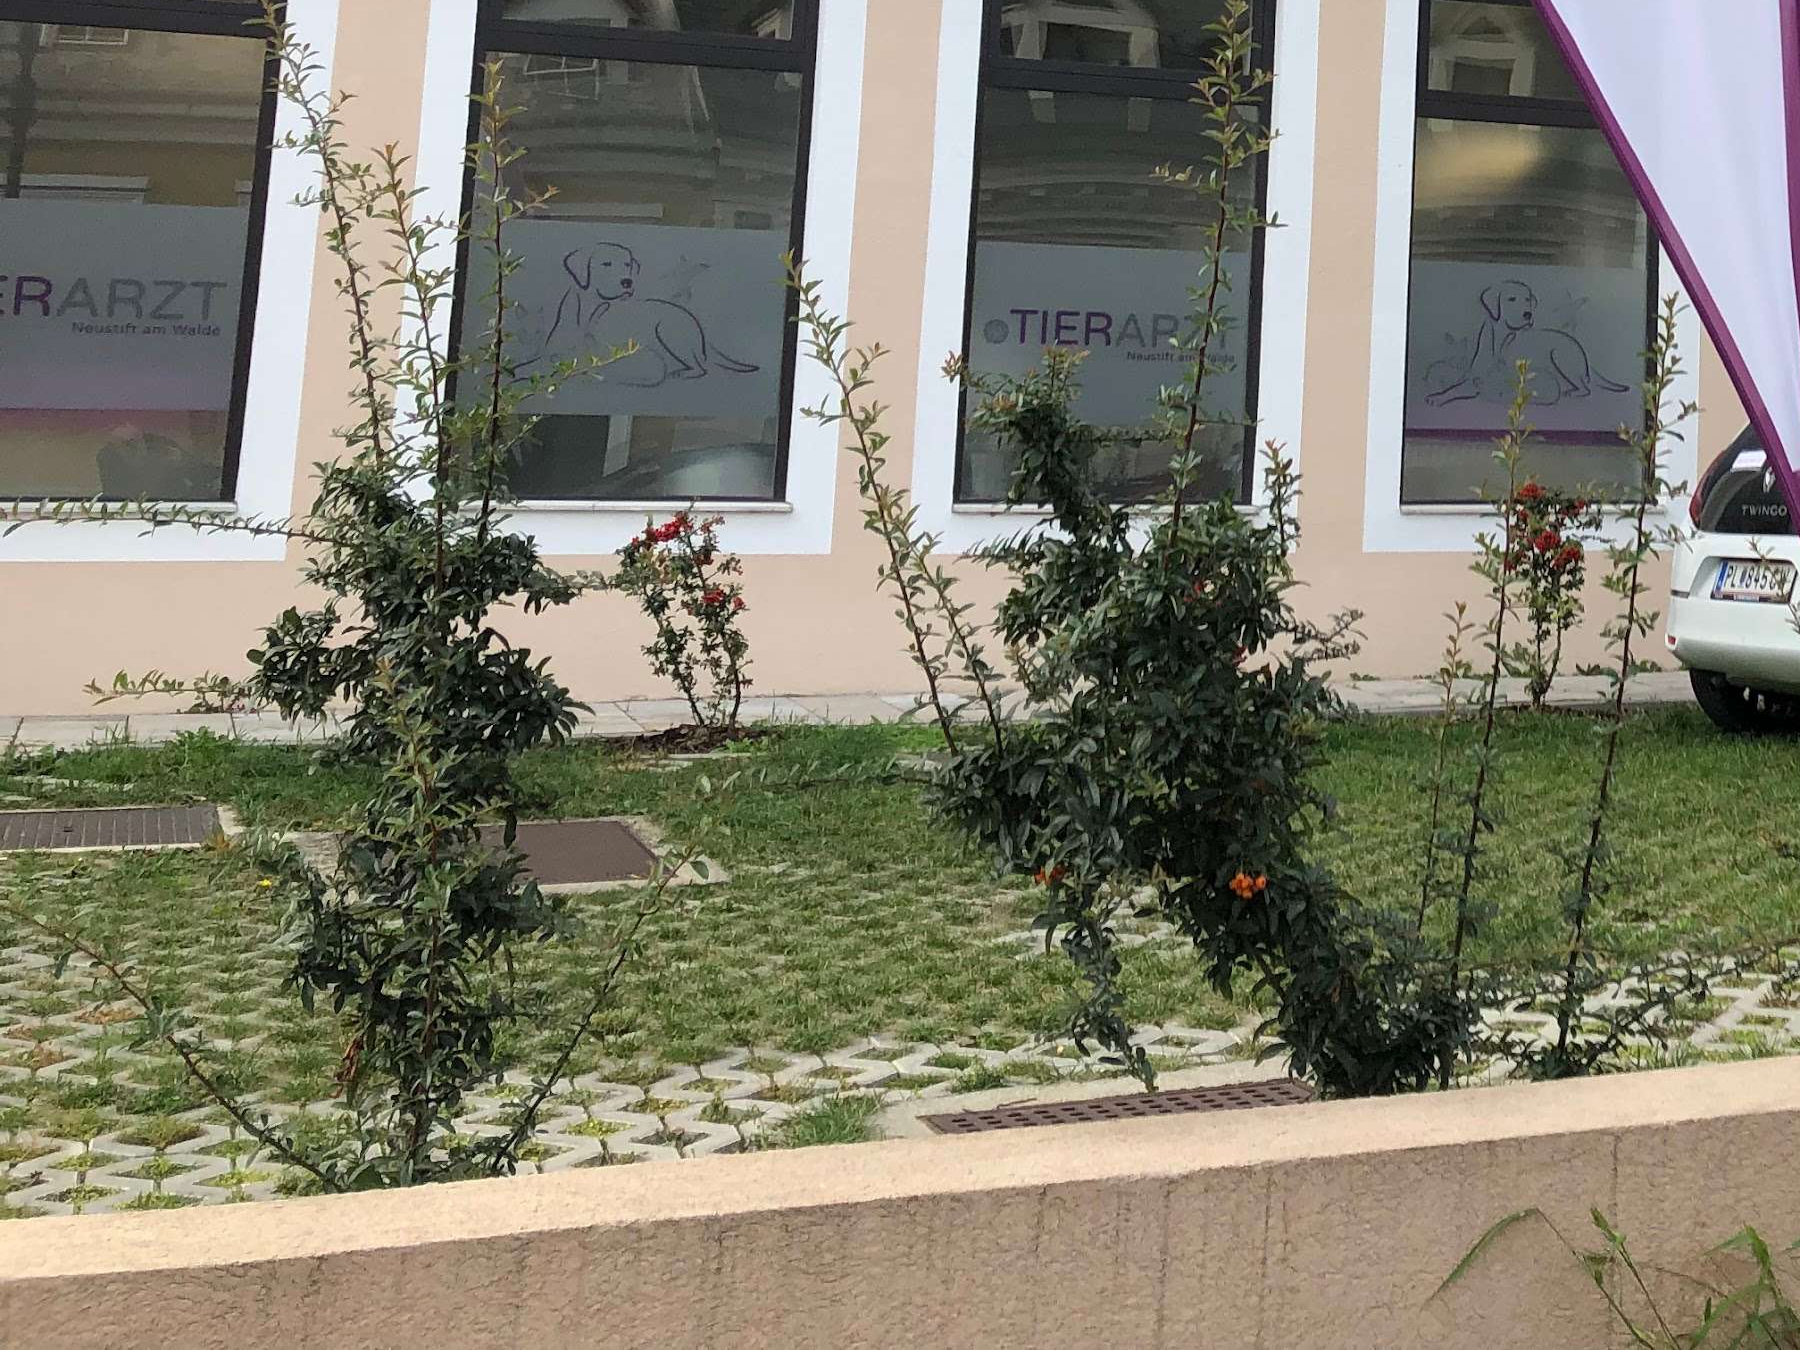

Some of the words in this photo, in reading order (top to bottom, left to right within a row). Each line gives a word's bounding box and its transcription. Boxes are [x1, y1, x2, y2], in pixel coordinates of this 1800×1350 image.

[0, 275, 228, 320] RARZT
[72, 321, 136, 335] Neustift
[143, 325, 167, 336] am
[173, 323, 221, 337] Walde
[1010, 309, 1238, 348] TIERAR
[1742, 504, 1787, 517] TWINGO
